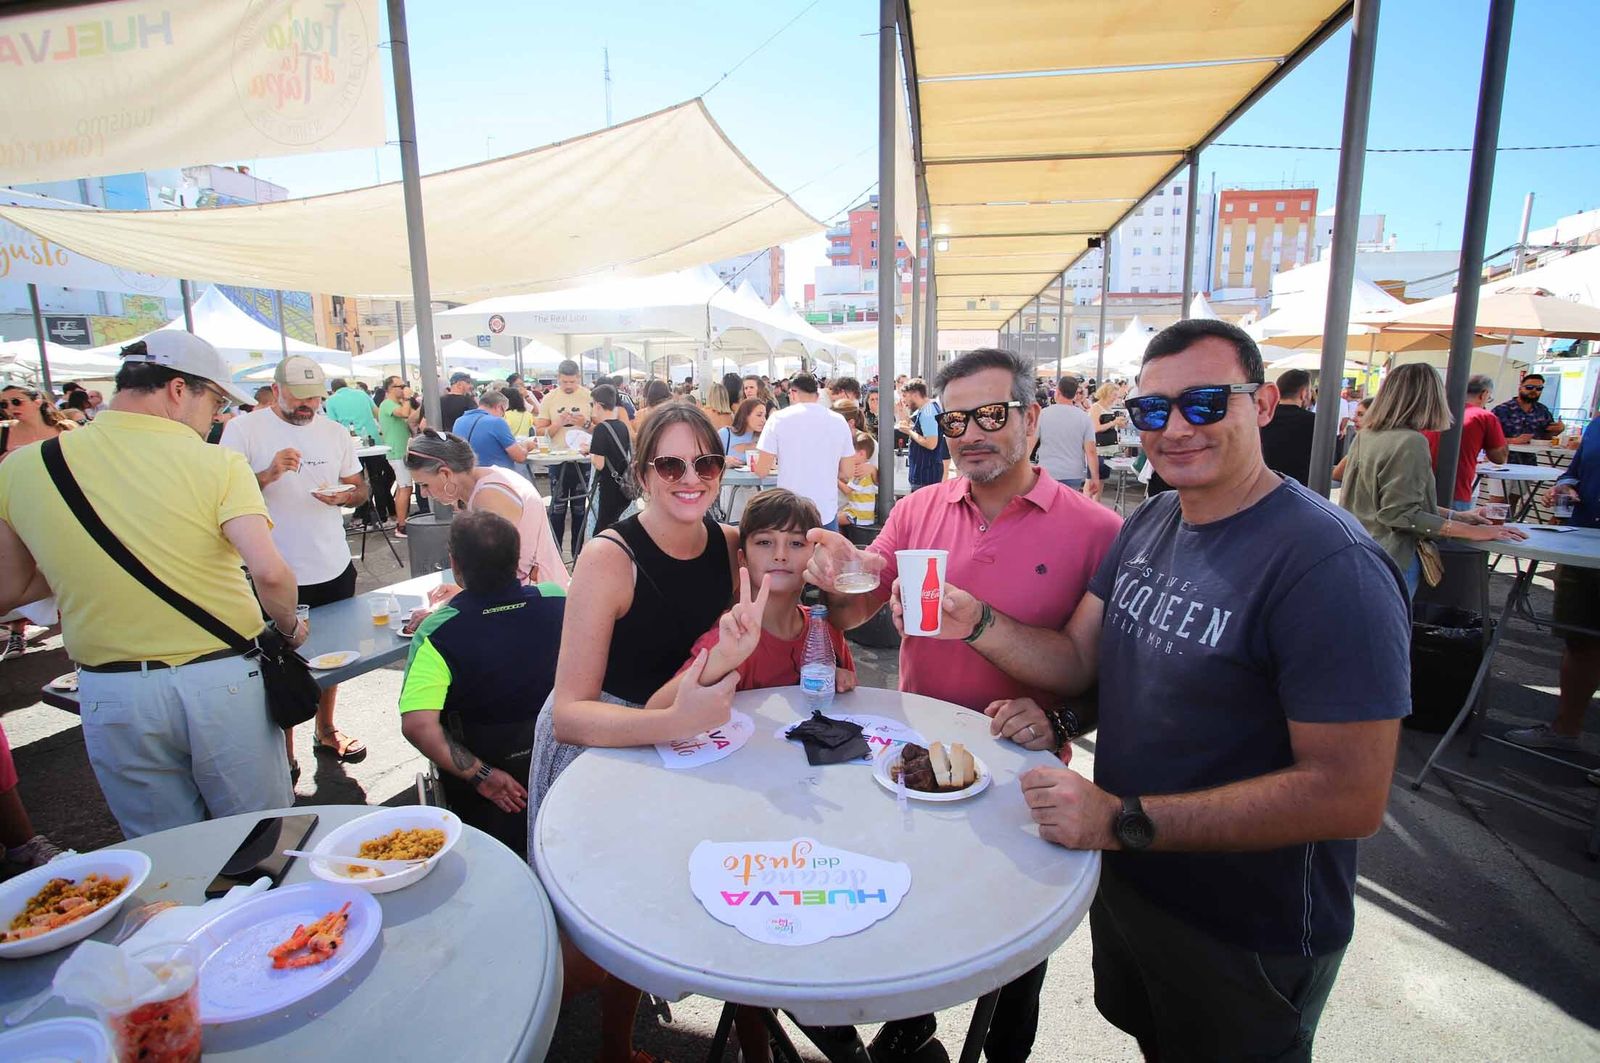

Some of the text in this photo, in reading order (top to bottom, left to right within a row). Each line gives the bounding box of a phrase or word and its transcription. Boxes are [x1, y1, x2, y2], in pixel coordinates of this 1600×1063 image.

[723, 841, 840, 886] del gusto
[720, 888, 887, 906] HUELVA
[760, 869, 868, 911] decana
